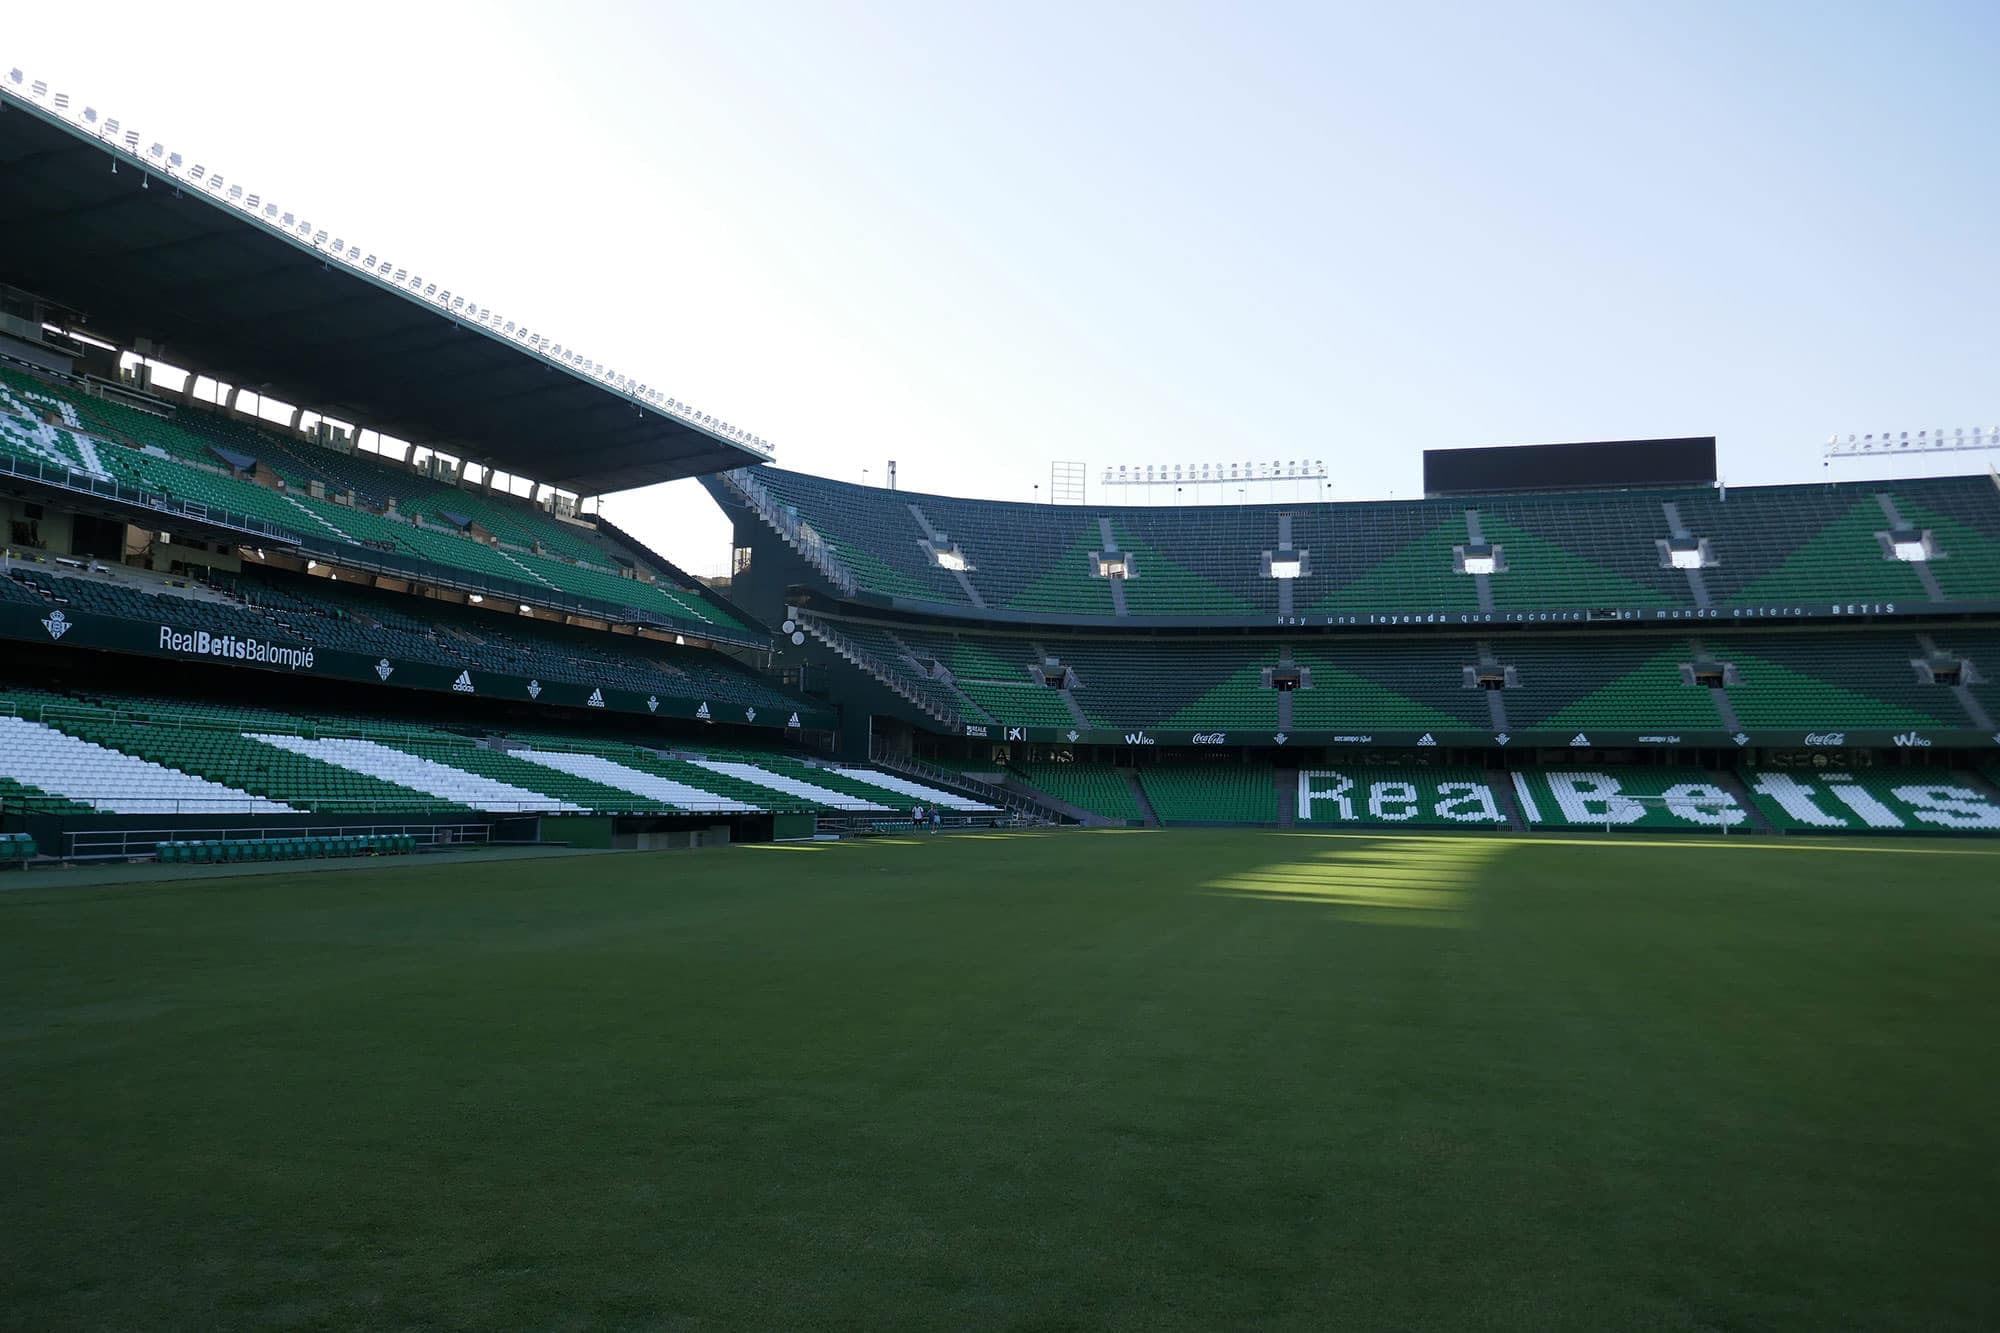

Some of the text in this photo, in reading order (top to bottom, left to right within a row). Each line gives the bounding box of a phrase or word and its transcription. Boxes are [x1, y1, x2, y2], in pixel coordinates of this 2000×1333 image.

[1277, 603, 1894, 626] Hay una leyenda que recorre el mundo entero. BETIS
[1298, 770, 2000, 830] Real Betis
